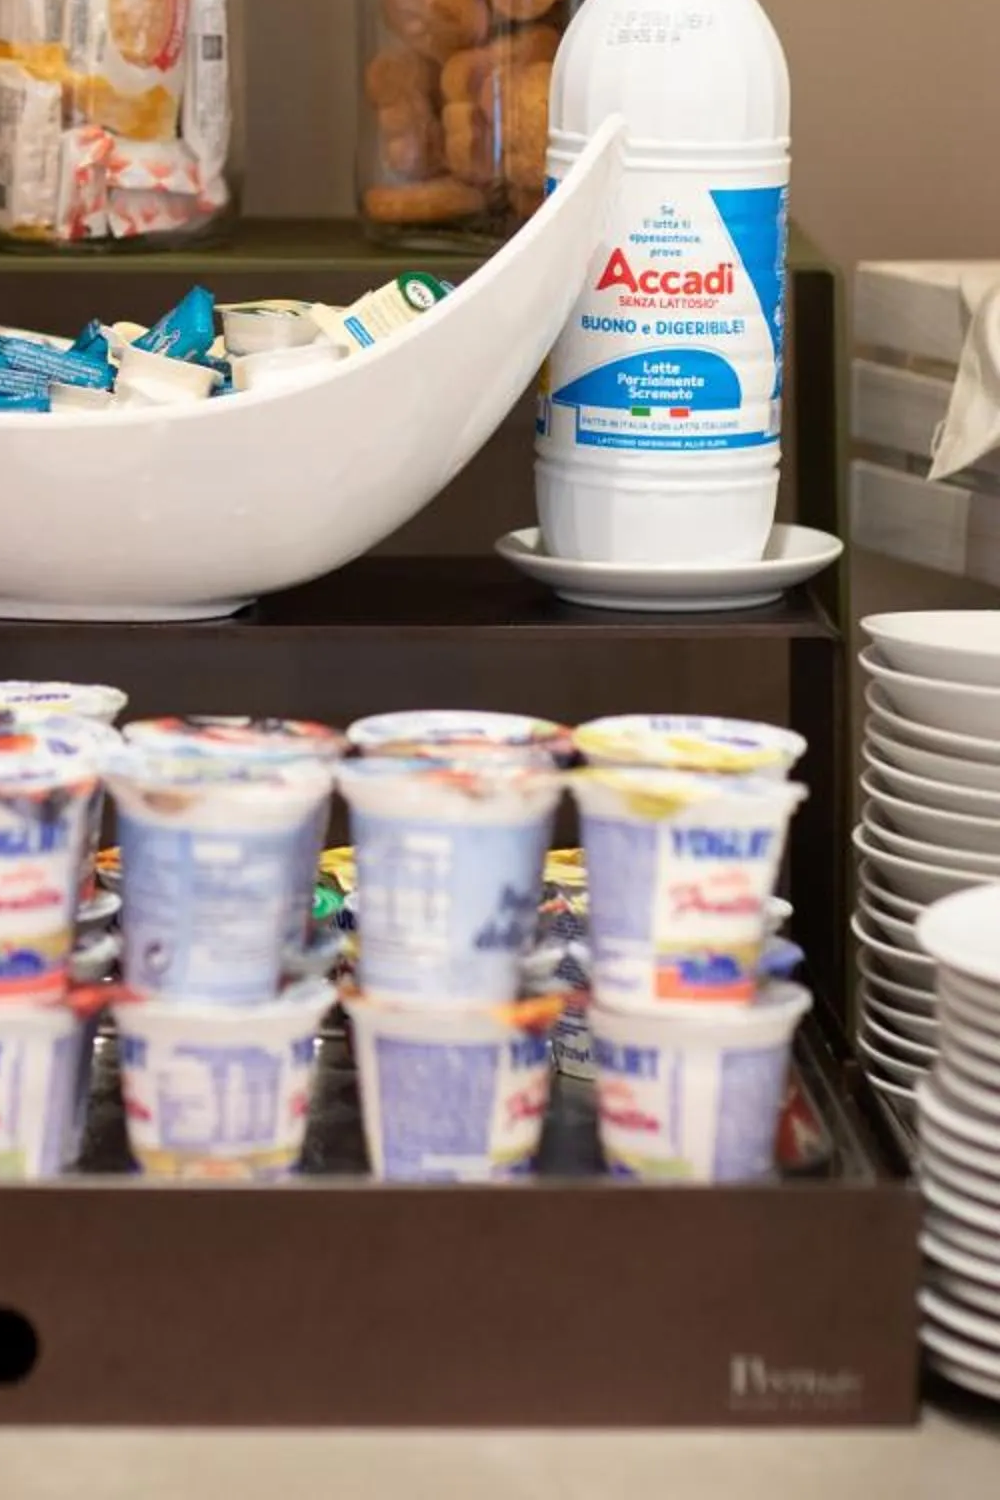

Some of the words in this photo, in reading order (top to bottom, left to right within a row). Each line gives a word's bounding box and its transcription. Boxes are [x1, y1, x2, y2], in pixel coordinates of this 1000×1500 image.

[595, 247, 735, 294] Accadi
[619, 296, 656, 308] SENZA
[581, 315, 637, 334] BUONO
[641, 323, 650, 334] e
